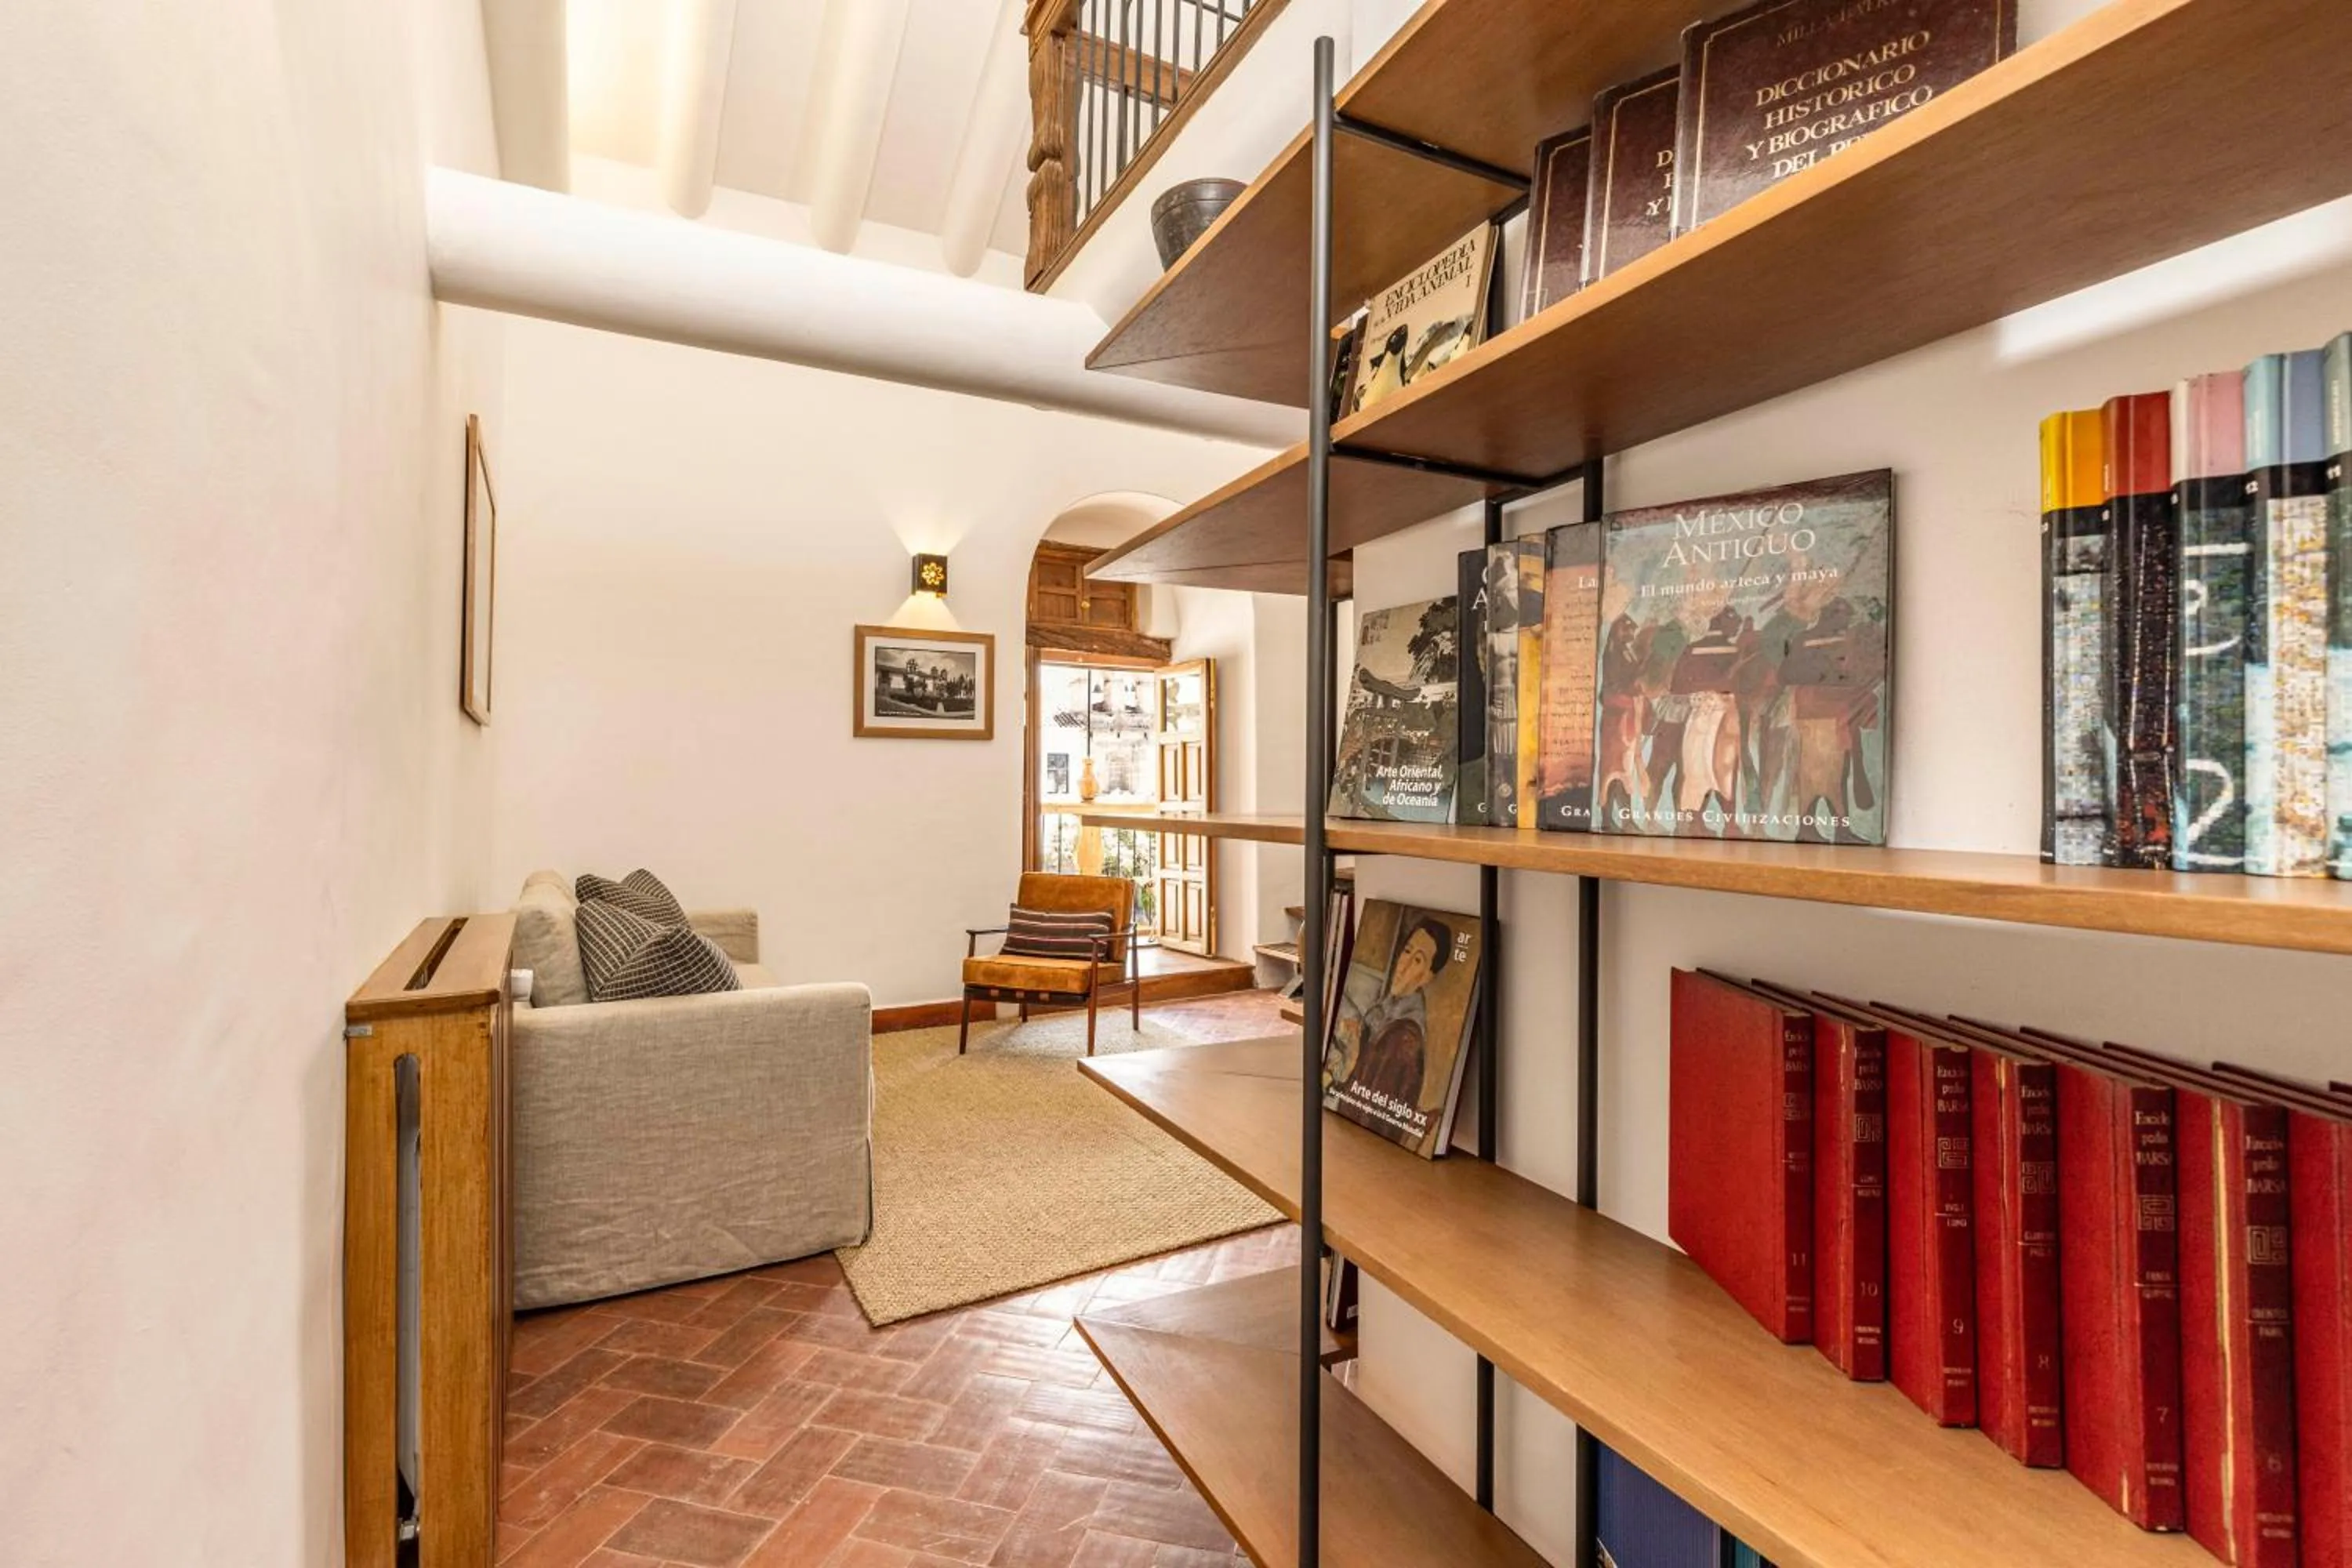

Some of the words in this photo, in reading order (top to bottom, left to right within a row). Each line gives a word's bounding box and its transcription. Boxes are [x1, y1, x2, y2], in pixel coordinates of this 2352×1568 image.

[1755, 31, 1930, 107] DICCIONARIO
[1765, 64, 1916, 129] HISTORICO
[1745, 140, 1765, 161] Y
[1768, 85, 1933, 154] BIOGRAFICO
[1672, 503, 1804, 540] MÉXICO
[1662, 529, 1816, 568] ANTIGUO
[1641, 584, 1655, 597] El
[1661, 579, 1715, 596] mundo
[1720, 575, 1770, 587] azteca
[1777, 573, 1786, 584] y
[1791, 568, 1838, 582] maya
[1376, 765, 1397, 778] Arte
[1382, 792, 1396, 804] de
[1389, 779, 1432, 793] Africano
[1430, 782, 1442, 797] y
[1457, 931, 1472, 945] ar
[1350, 1080, 1371, 1099] Arte
[1371, 1091, 1388, 1107] del
[1388, 1098, 1412, 1118] siglo
[1953, 1318, 1964, 1334] 9
[2157, 1407, 2169, 1424] 7
